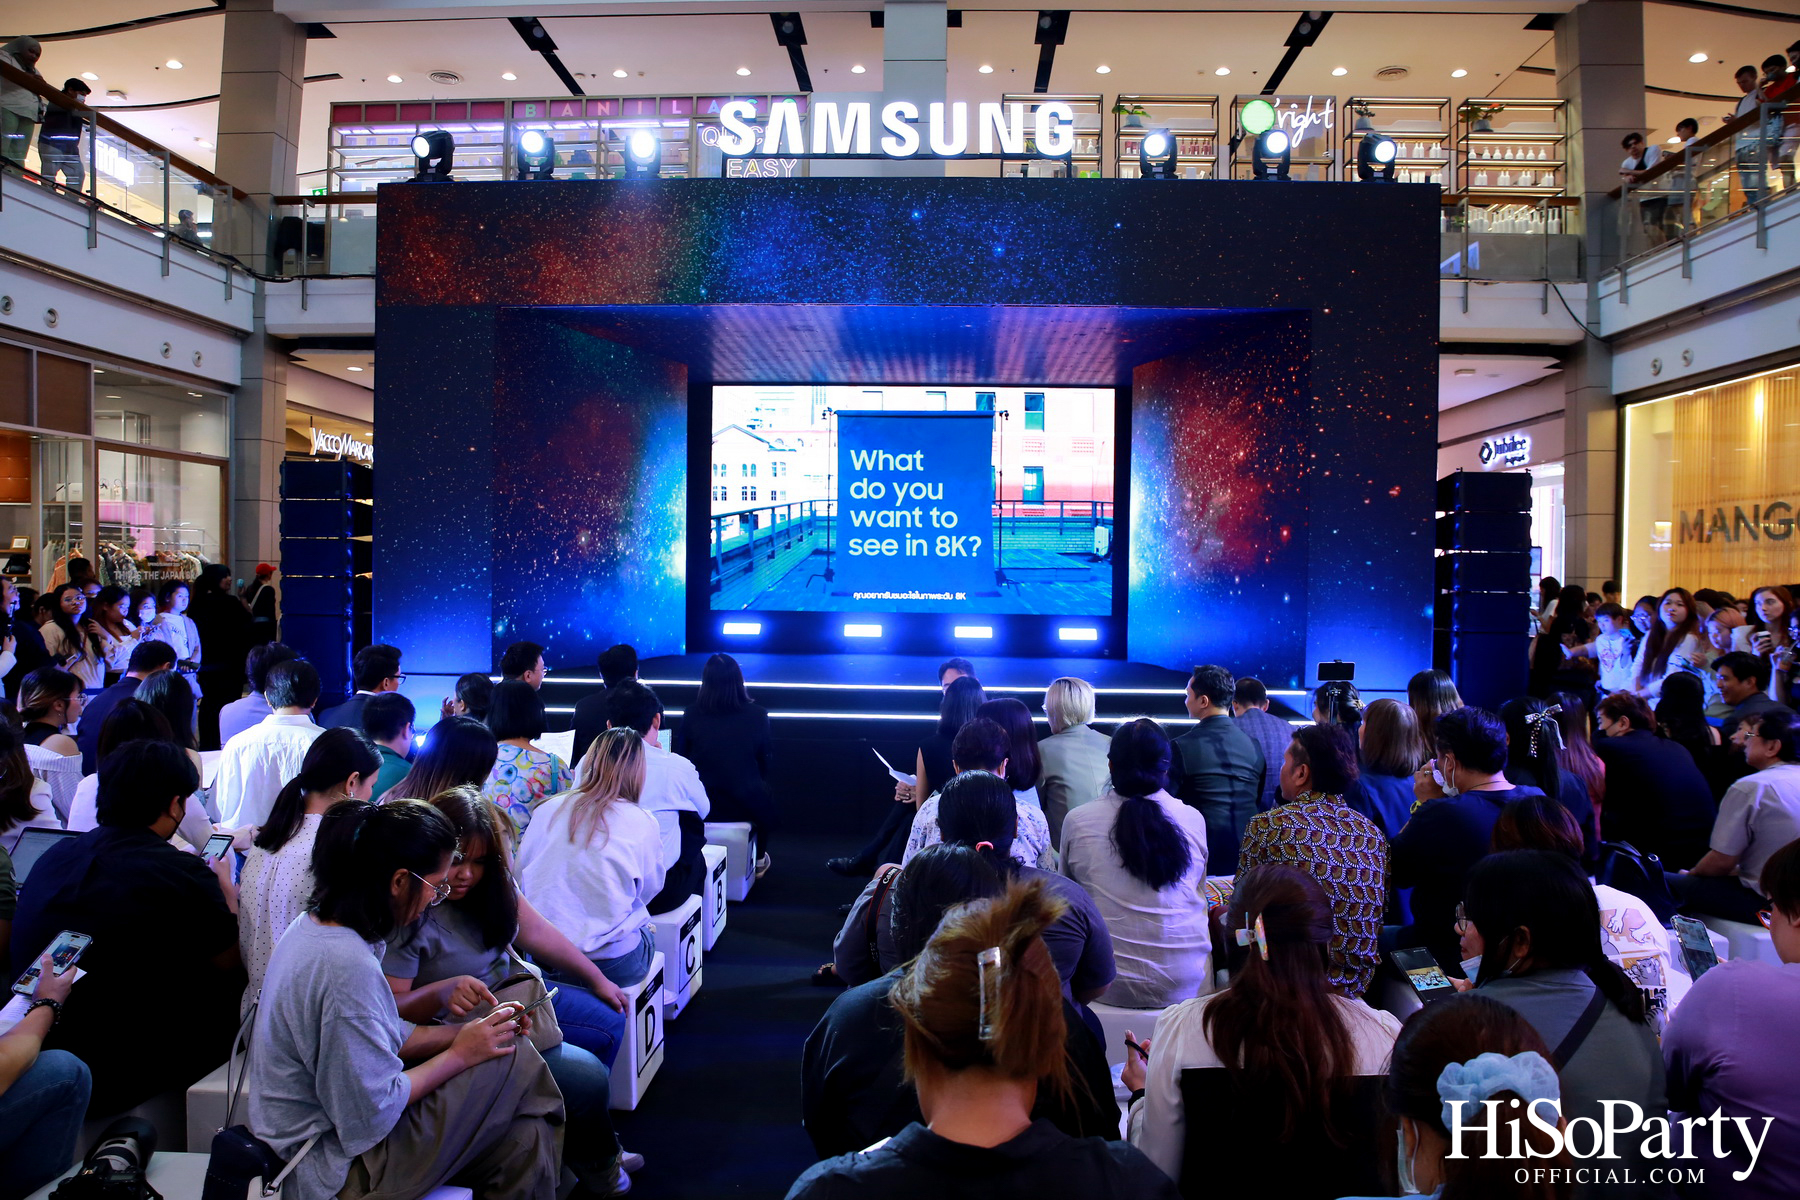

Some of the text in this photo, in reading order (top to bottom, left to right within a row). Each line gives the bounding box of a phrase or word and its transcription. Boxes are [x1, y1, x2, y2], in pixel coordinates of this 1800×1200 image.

[719, 101, 1074, 156] SAMSUNG
[726, 158, 798, 173] EASY
[850, 449, 924, 471] What
[850, 477, 944, 506] do you
[850, 506, 958, 528] want to
[1679, 501, 1800, 544] MANG
[849, 532, 982, 557] see in 8K?
[144, 571, 159, 580] THE
[160, 571, 184, 580] JAPAN
[955, 592, 966, 600] 8K
[717, 879, 723, 916] B
[685, 934, 696, 976] C
[645, 1004, 656, 1056] D
